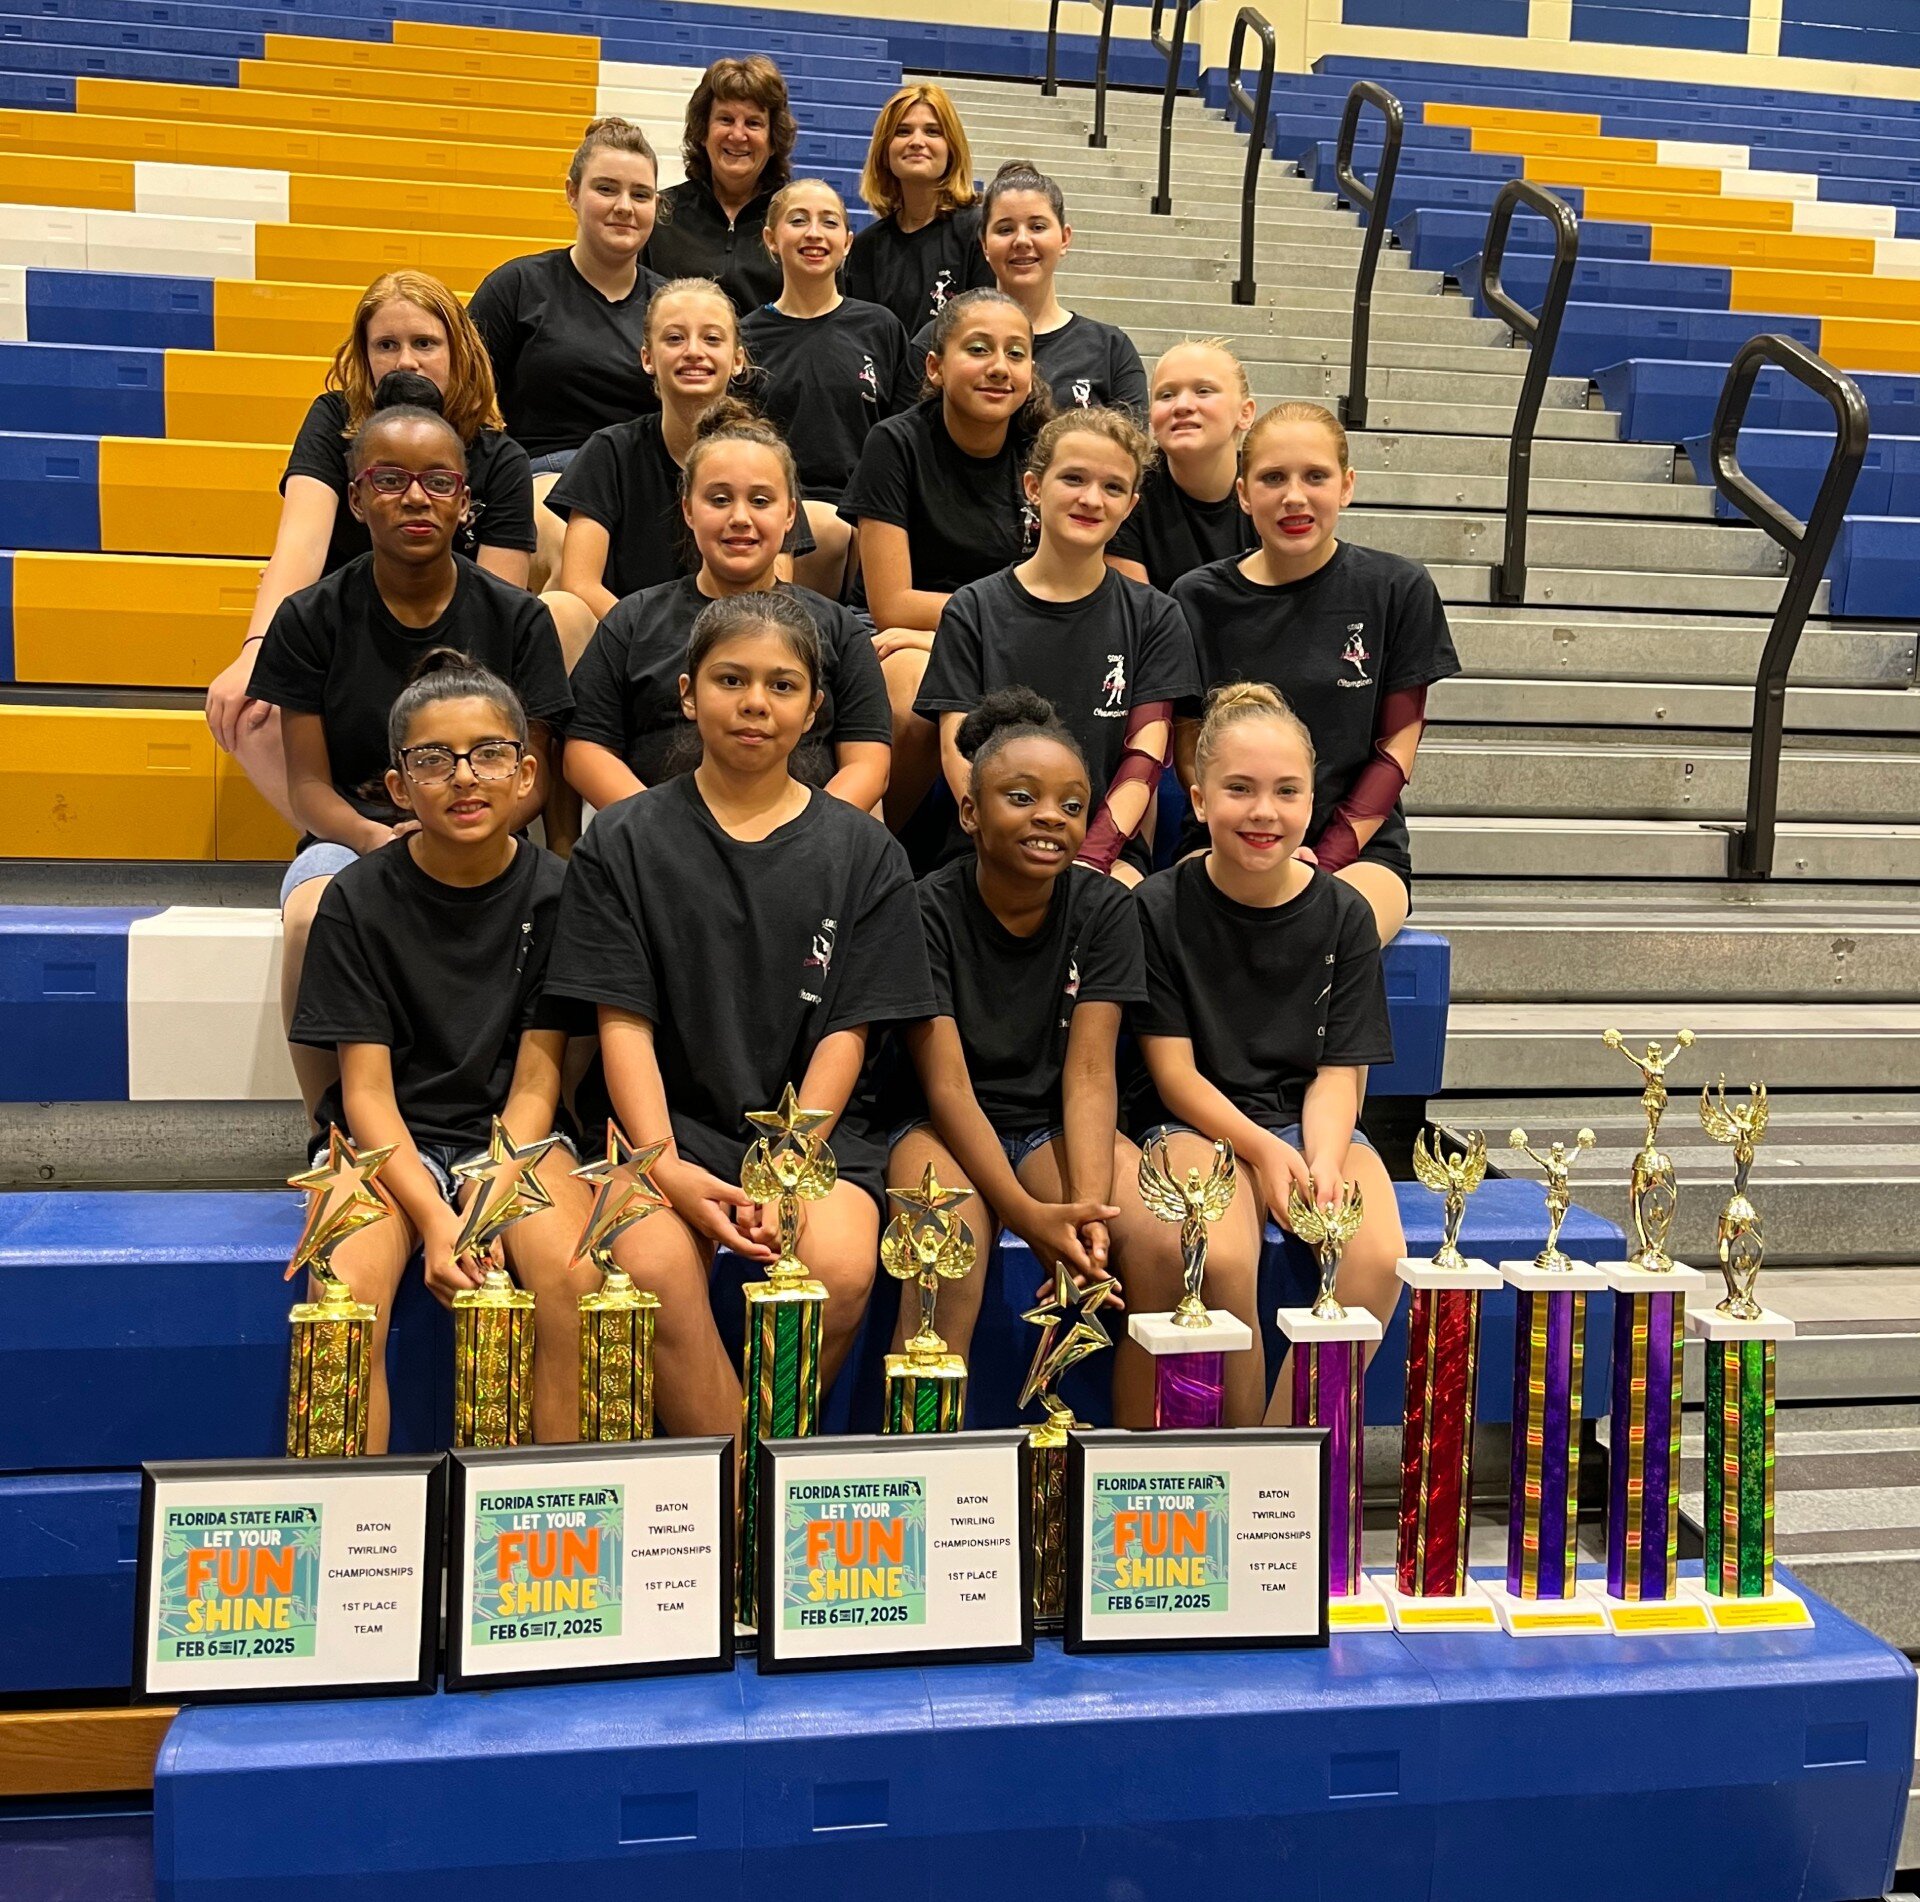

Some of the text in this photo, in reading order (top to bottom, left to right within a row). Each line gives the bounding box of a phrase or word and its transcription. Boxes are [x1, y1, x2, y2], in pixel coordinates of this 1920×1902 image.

[1685, 763, 1694, 775] D
[1097, 1478, 1213, 1491] FLORIDA STATE FAIR
[789, 1483, 910, 1500] FLORIDA STATE FAIR
[1259, 1491, 1290, 1499] BATON
[480, 1492, 606, 1511] FLORIDA STATE FAIR
[957, 1496, 989, 1505] BATON
[1127, 1495, 1195, 1511] LET YOUR
[655, 1503, 689, 1512] BATON
[821, 1502, 890, 1519] LET YOUR
[169, 1509, 304, 1527] FLORIDA STATE FAIR
[513, 1511, 586, 1531] LET YOUR
[1252, 1511, 1296, 1519] TWIRLING
[356, 1523, 391, 1532] BATON
[950, 1517, 995, 1526] TWIRLING
[648, 1525, 695, 1535] TWIRLING
[1113, 1510, 1207, 1556] FUN
[1236, 1531, 1311, 1541] CHAMPIONSHIPS
[204, 1530, 281, 1548] LET YOUR
[806, 1518, 905, 1569] FUN
[933, 1538, 1011, 1548] CHAMPIONSHIPS
[348, 1546, 397, 1555] TWIRLING
[497, 1527, 599, 1582] FUN
[631, 1546, 712, 1558] CHAMPIONSHIPS
[186, 1546, 296, 1598] FUN
[328, 1567, 413, 1578] CHAMPIONSHIPS
[1249, 1562, 1298, 1571] 1ST PLACE
[948, 1571, 998, 1581] 1ST PLACE
[1114, 1557, 1206, 1589] SHINE
[645, 1580, 697, 1590] 1ST PLACE
[807, 1567, 903, 1602] SHINE
[1261, 1584, 1286, 1592] TEAM
[497, 1578, 598, 1616] SHINE
[960, 1593, 986, 1602] TEAM
[1108, 1596, 1132, 1610] FEB
[1174, 1594, 1210, 1608] 2025
[342, 1602, 397, 1611] 1ST PLACE
[657, 1603, 685, 1612] TEAM
[185, 1597, 292, 1633] SHINE
[801, 1610, 826, 1625] FEB
[871, 1606, 908, 1622] 2025
[354, 1625, 383, 1634] TEAM
[490, 1625, 516, 1640] FEB
[563, 1618, 603, 1635] 2025
[176, 1641, 205, 1657] FEB
[253, 1638, 295, 1654] 2025
